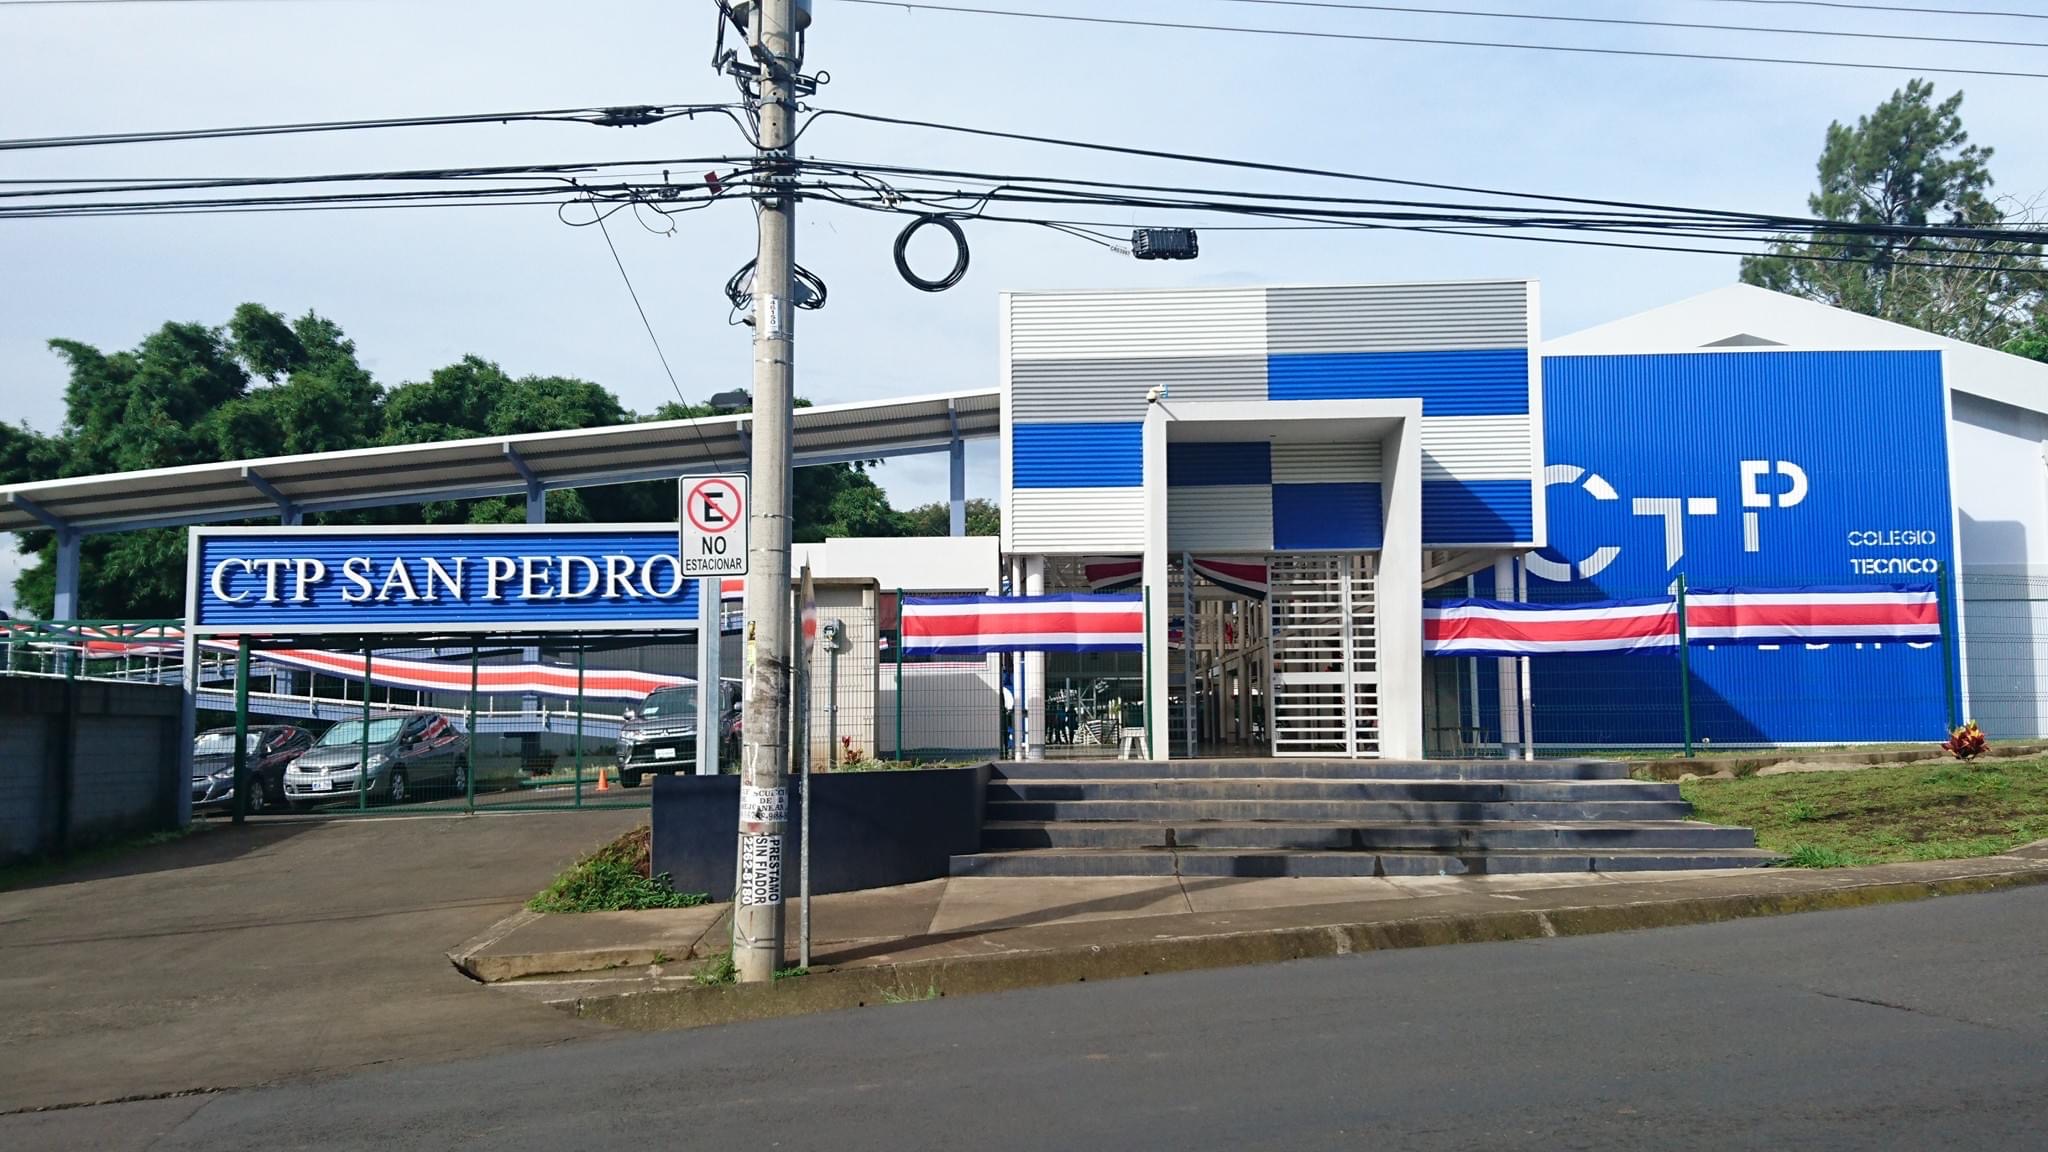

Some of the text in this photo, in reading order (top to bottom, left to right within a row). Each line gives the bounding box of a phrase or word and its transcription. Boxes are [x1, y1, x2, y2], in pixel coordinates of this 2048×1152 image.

[702, 535, 727, 555] NO
[1525, 460, 1808, 595] CTP
[1847, 530, 1936, 546] COLEGIO
[211, 553, 683, 603] CTP SAN PEDRO
[685, 558, 742, 571] ESTACIONAR
[1849, 558, 1938, 574] TECNICO
[754, 837, 768, 904] SIN FIADOR
[768, 839, 781, 902] PRESTAMO
